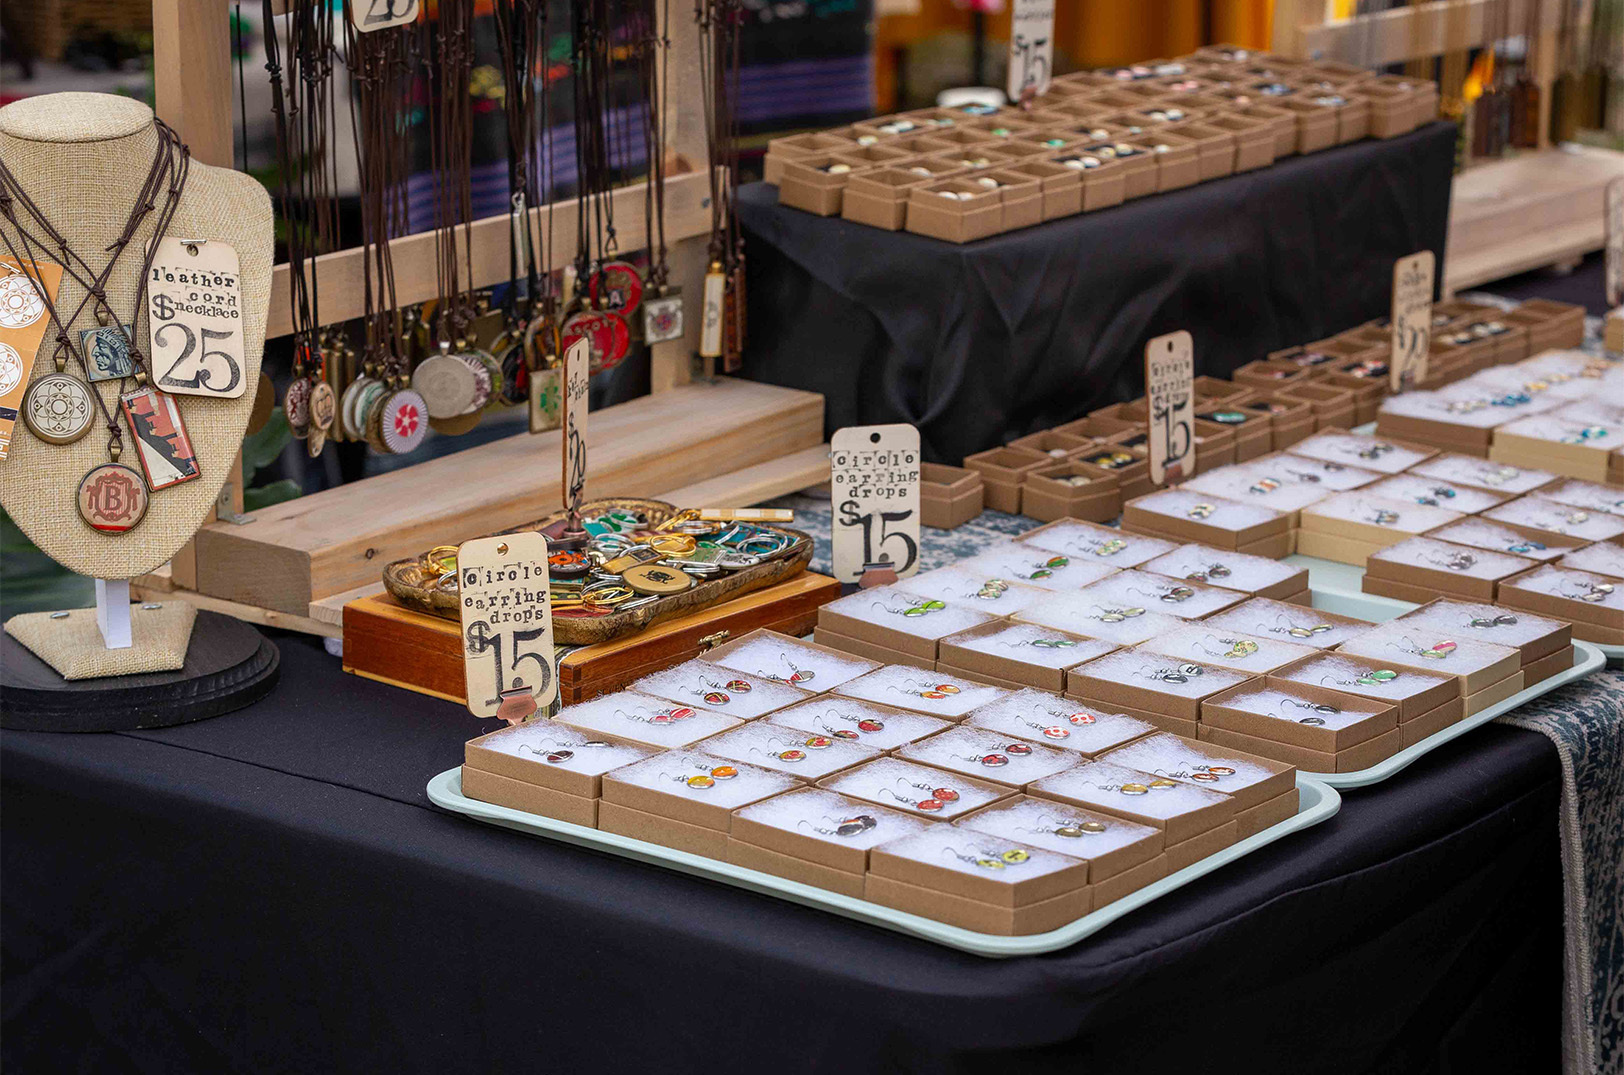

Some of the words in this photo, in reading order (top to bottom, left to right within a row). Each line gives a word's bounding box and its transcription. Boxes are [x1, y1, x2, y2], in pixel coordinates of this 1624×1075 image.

[152, 268, 235, 288] leather
[189, 292, 237, 307] cord
[174, 301, 239, 319] necklace
[836, 454, 914, 468] circle
[835, 470, 919, 484] earring
[103, 484, 123, 511] B
[848, 486, 907, 499] drops
[464, 590, 547, 609] earring
[489, 608, 544, 625] drops
